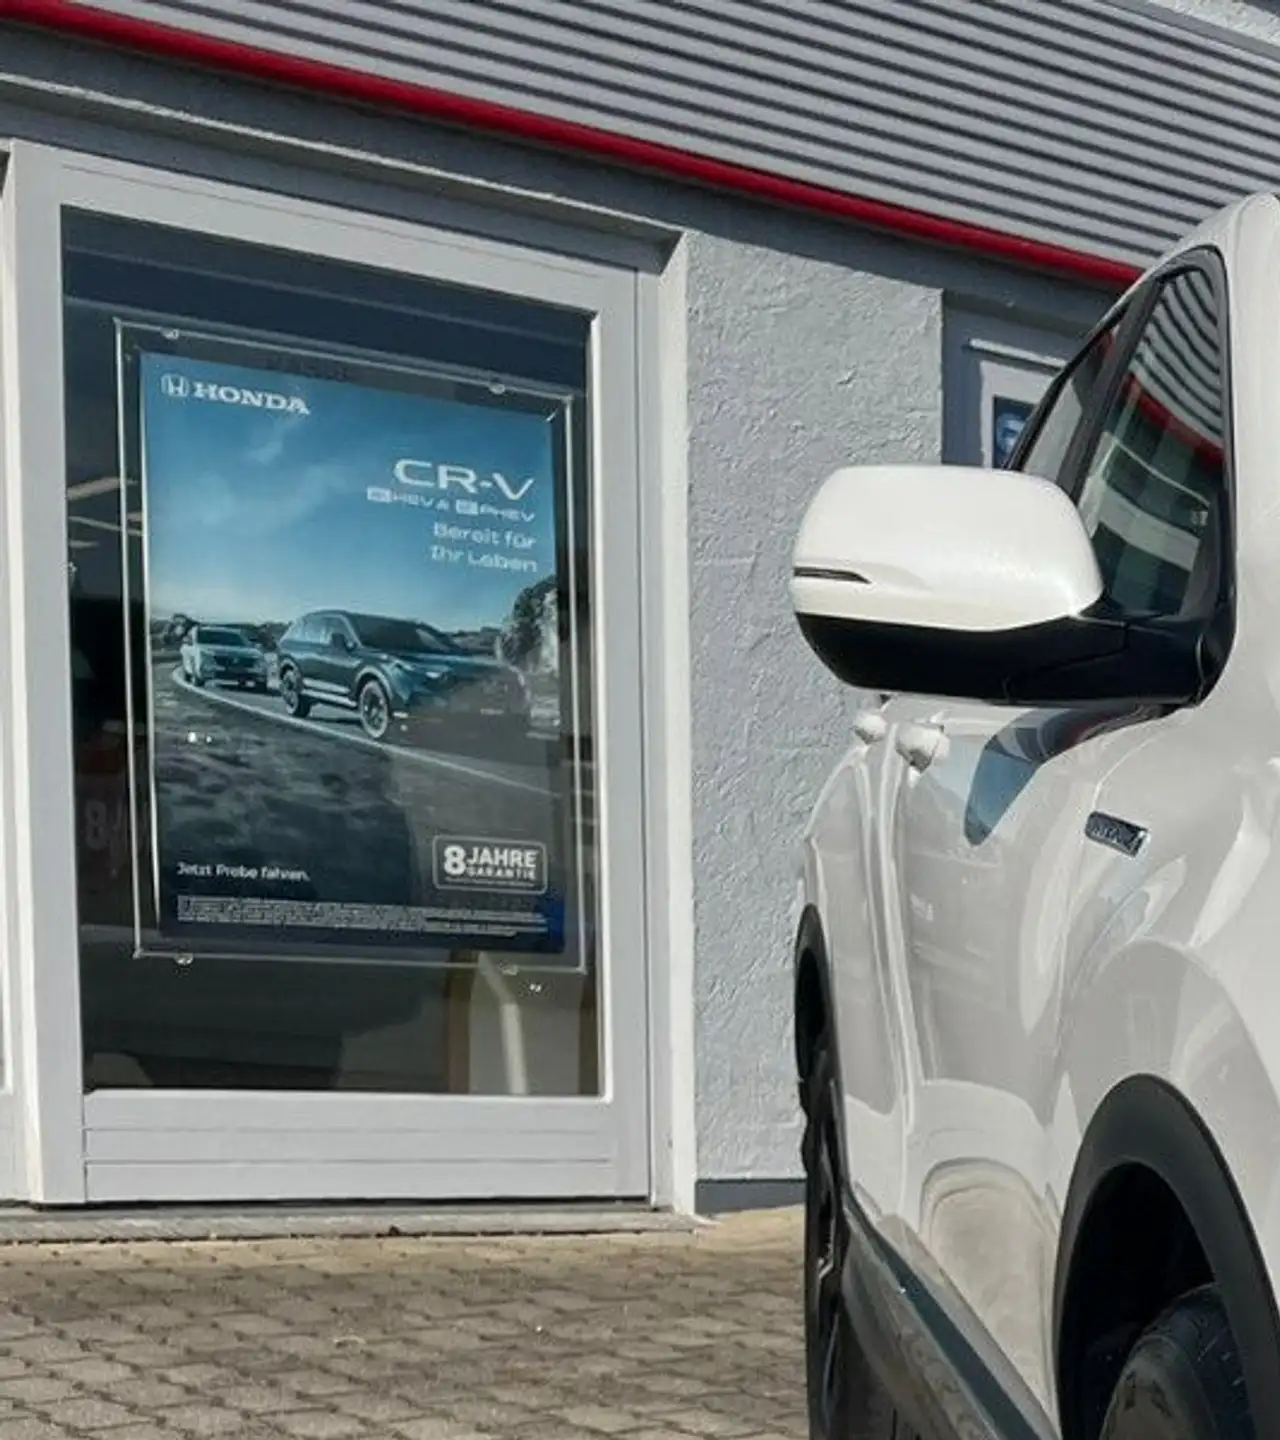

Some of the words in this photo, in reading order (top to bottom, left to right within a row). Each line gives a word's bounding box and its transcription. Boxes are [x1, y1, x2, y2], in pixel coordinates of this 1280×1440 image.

[193, 381, 311, 415] HONDA
[393, 458, 536, 501] CR-V
[443, 844, 466, 876] 8
[466, 846, 539, 869] JAHRE
